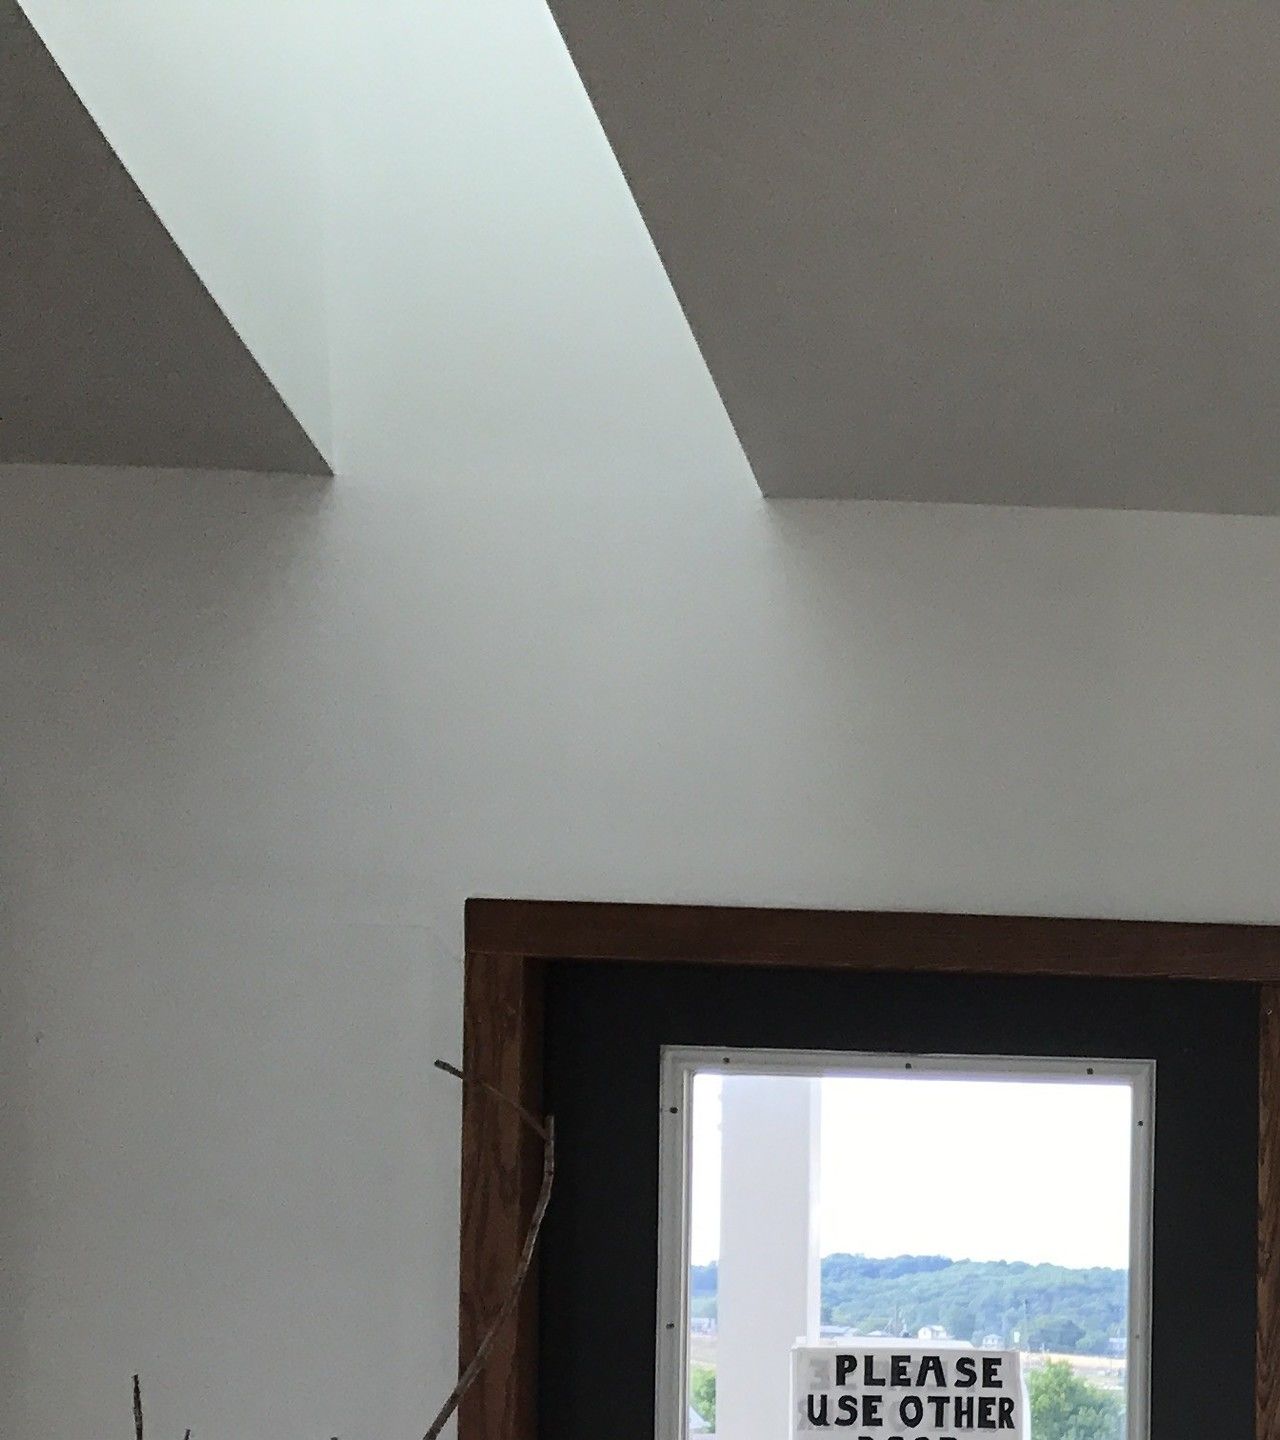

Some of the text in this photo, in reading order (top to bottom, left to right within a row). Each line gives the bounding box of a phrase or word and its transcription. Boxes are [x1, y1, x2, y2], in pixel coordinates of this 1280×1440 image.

[836, 1355, 1002, 1388] PLEASE
[808, 1395, 1015, 1429] USE OTHER
